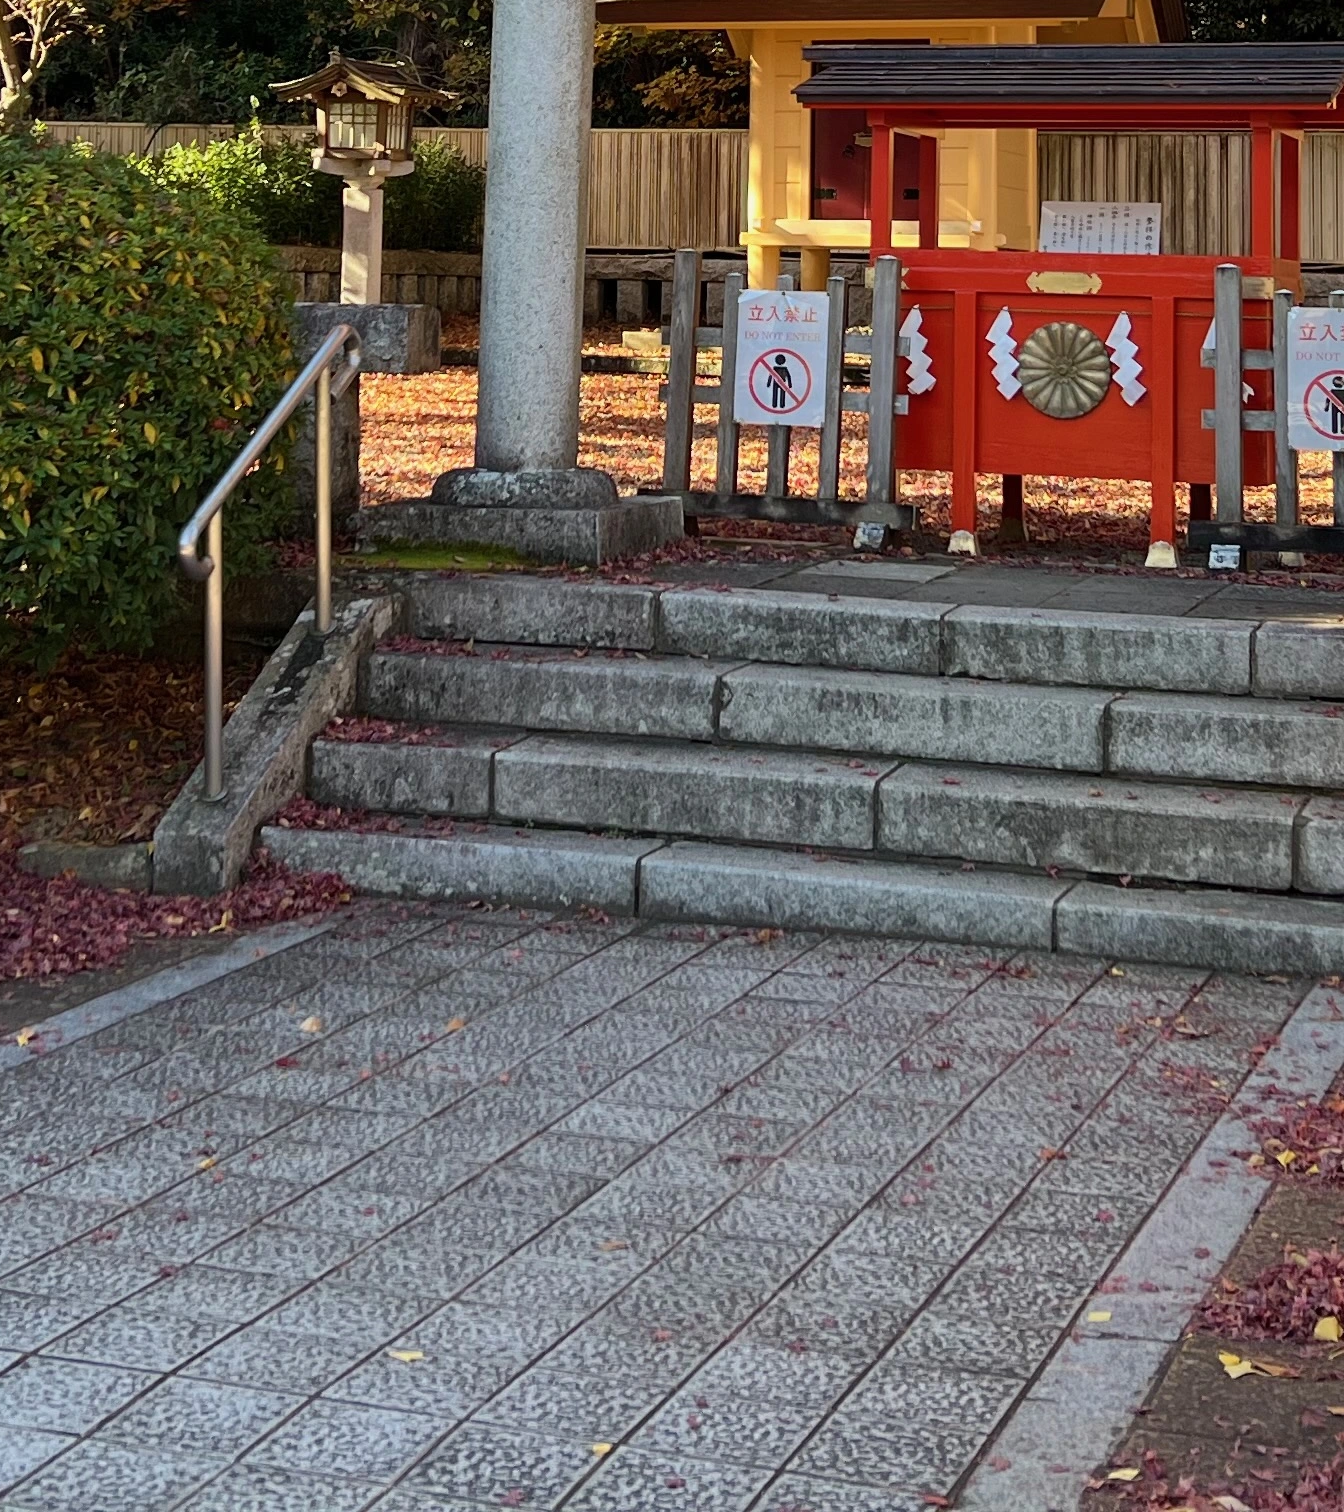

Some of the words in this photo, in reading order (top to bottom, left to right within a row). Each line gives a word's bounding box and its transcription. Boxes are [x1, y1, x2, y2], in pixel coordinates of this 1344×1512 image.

[747, 304, 818, 323] 立入禁止
[744, 331, 760, 340] DO
[762, 331, 784, 341] NOT
[786, 332, 821, 342] ENTER
[1295, 351, 1312, 361] DO
[1316, 351, 1341, 362] NOT
